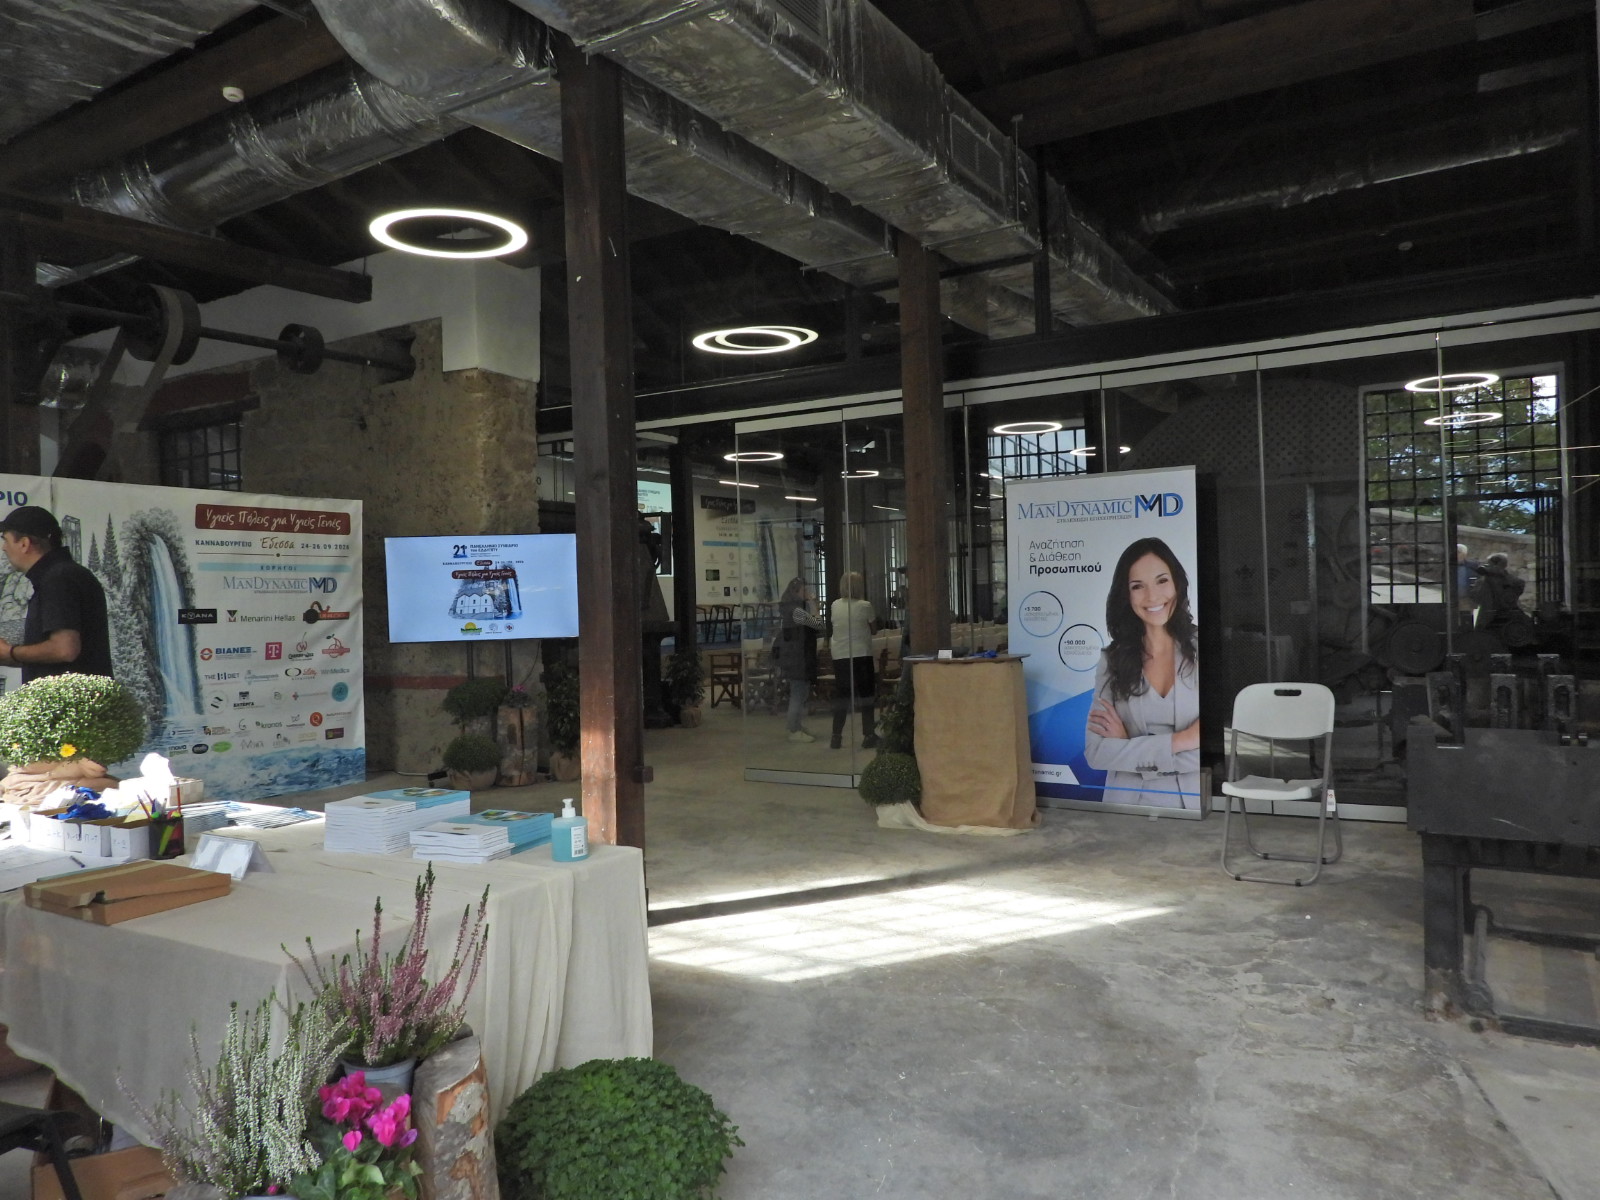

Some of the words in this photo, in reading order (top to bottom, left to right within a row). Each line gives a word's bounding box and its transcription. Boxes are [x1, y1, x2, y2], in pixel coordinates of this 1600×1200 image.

[271, 515, 287, 531] για
[1029, 538, 1085, 550] Αναζήτηση
[1029, 552, 1036, 562] &
[1038, 551, 1082, 562] Διάθεση
[1029, 562, 1102, 577] Προσωπικού
[240, 614, 273, 623] Menarini
[275, 614, 296, 622] Hellas
